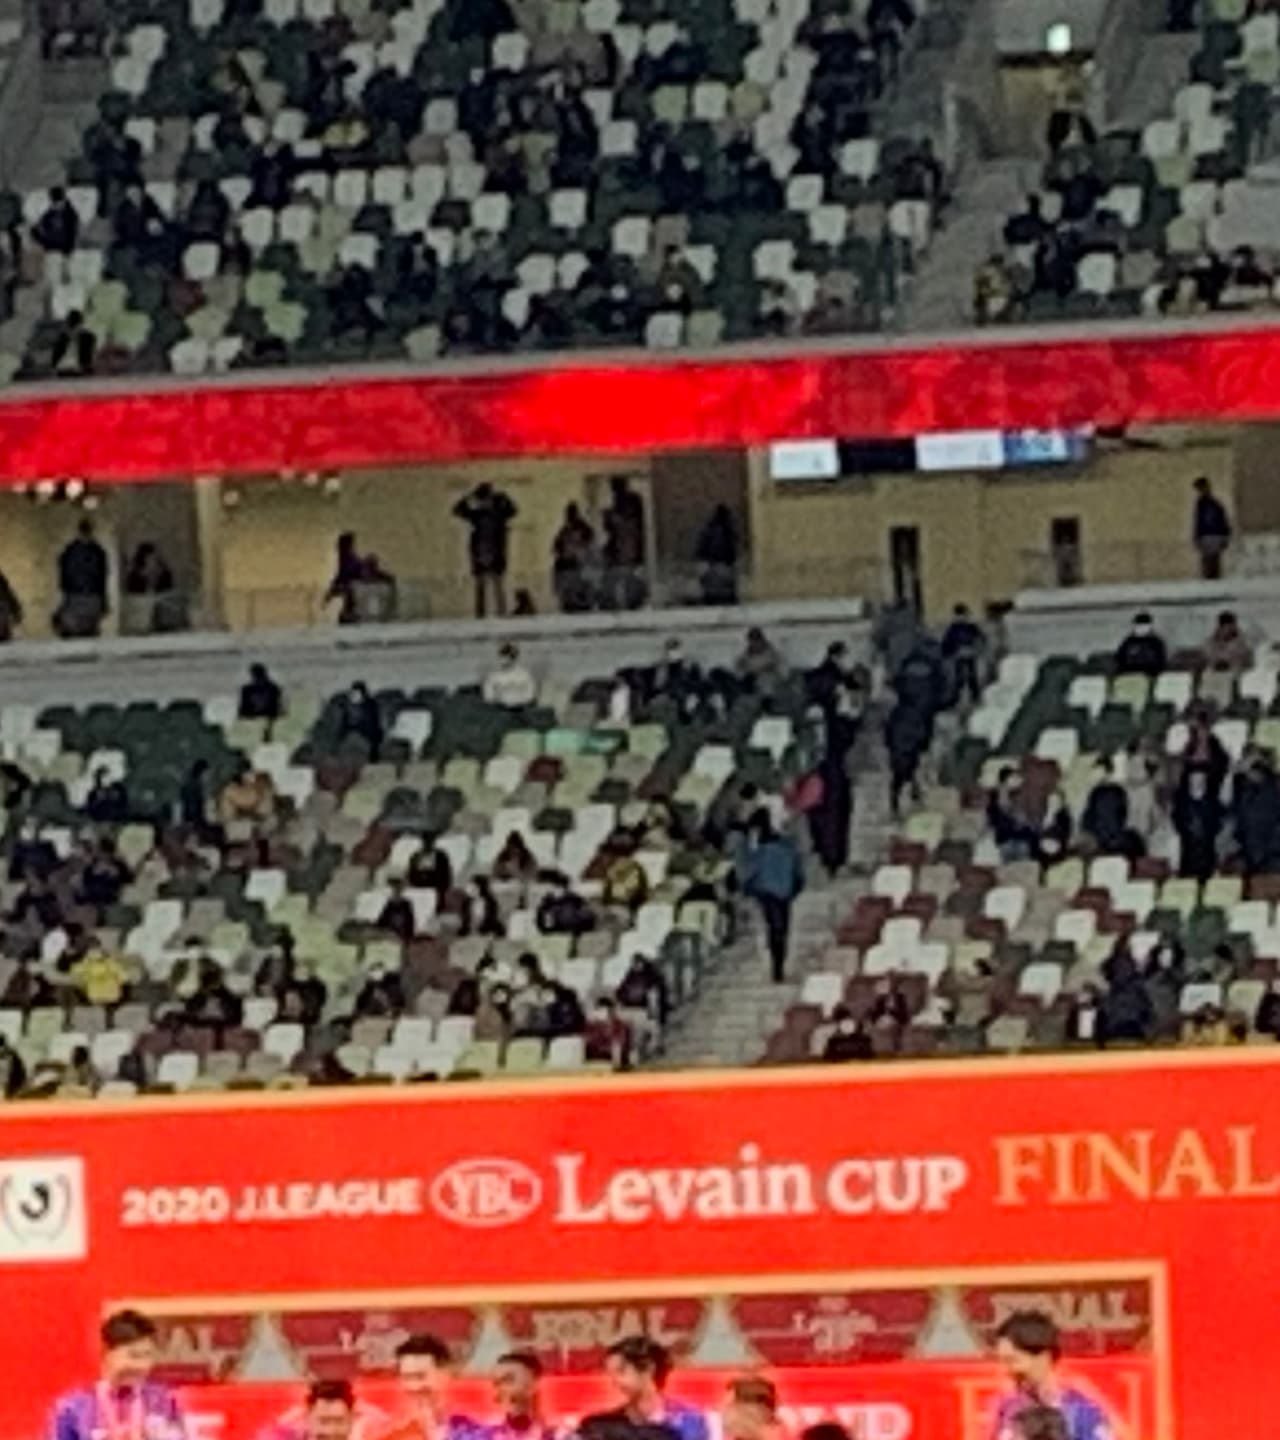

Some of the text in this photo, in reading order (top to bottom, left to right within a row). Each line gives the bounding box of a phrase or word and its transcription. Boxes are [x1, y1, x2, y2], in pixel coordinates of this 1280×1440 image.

[121, 1187, 230, 1225] 2020
[235, 1177, 424, 1222] J.LEAGUE
[554, 1143, 816, 1223] Levain
[828, 1154, 967, 1216] CUP
